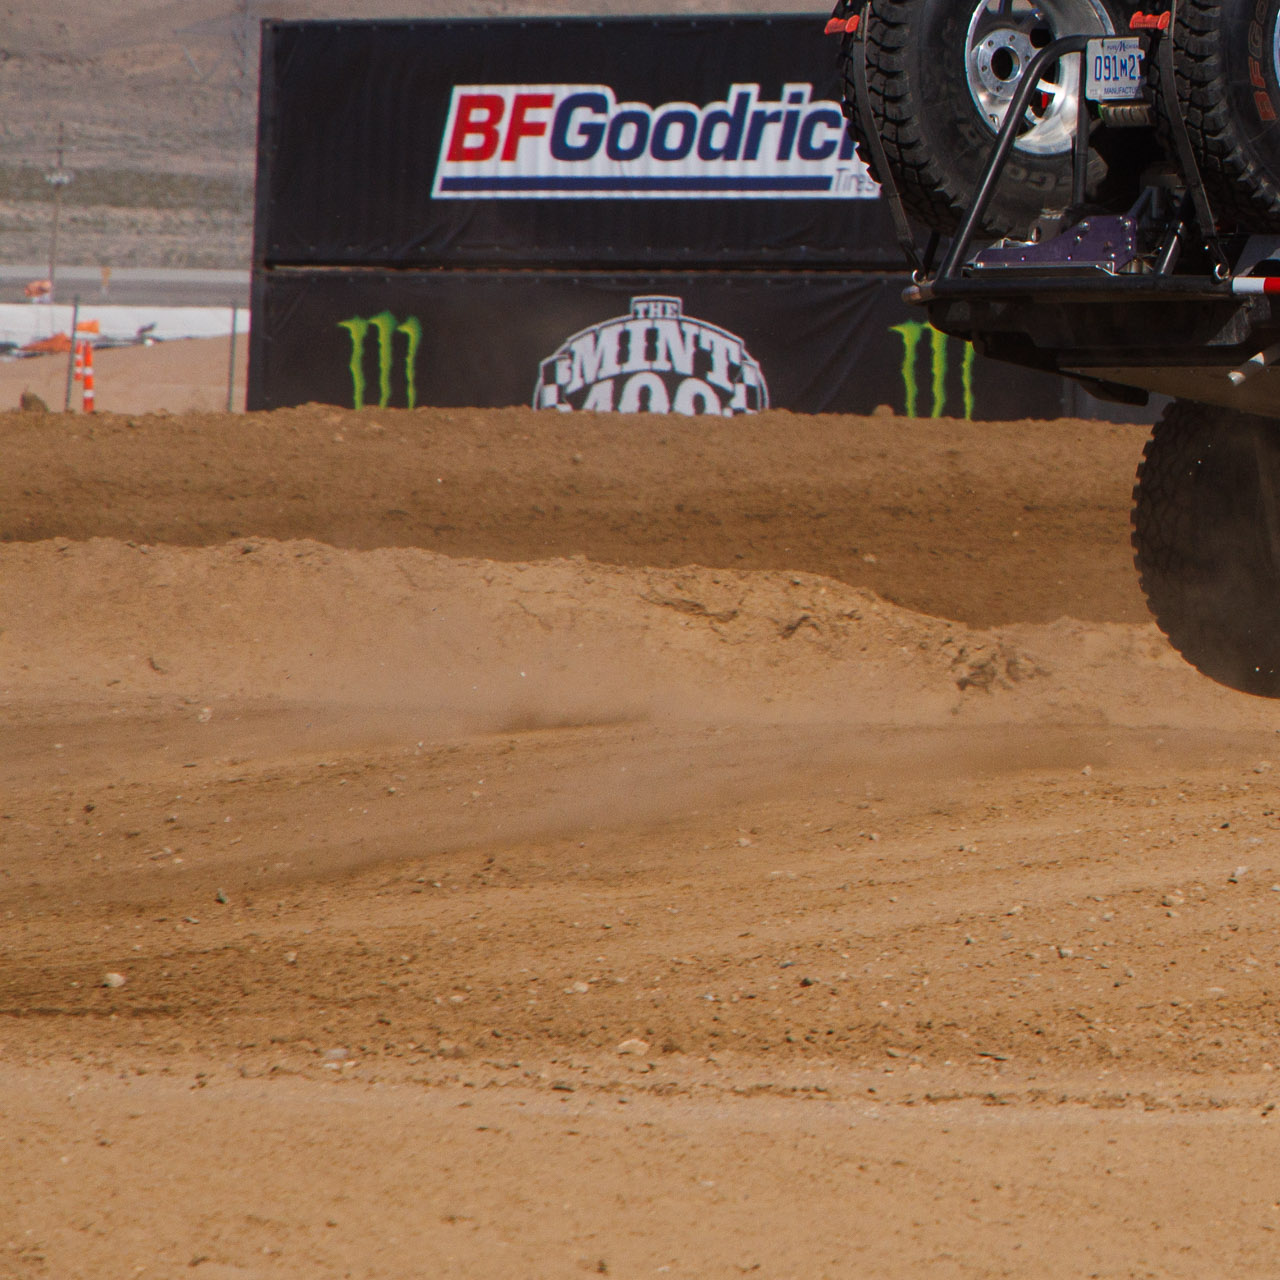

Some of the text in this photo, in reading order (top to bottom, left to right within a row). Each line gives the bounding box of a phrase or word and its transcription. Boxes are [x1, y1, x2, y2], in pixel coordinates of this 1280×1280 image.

[1104, 86, 1139, 96] MANUFACTU
[633, 302, 680, 319] THE
[565, 319, 742, 396] MINT
